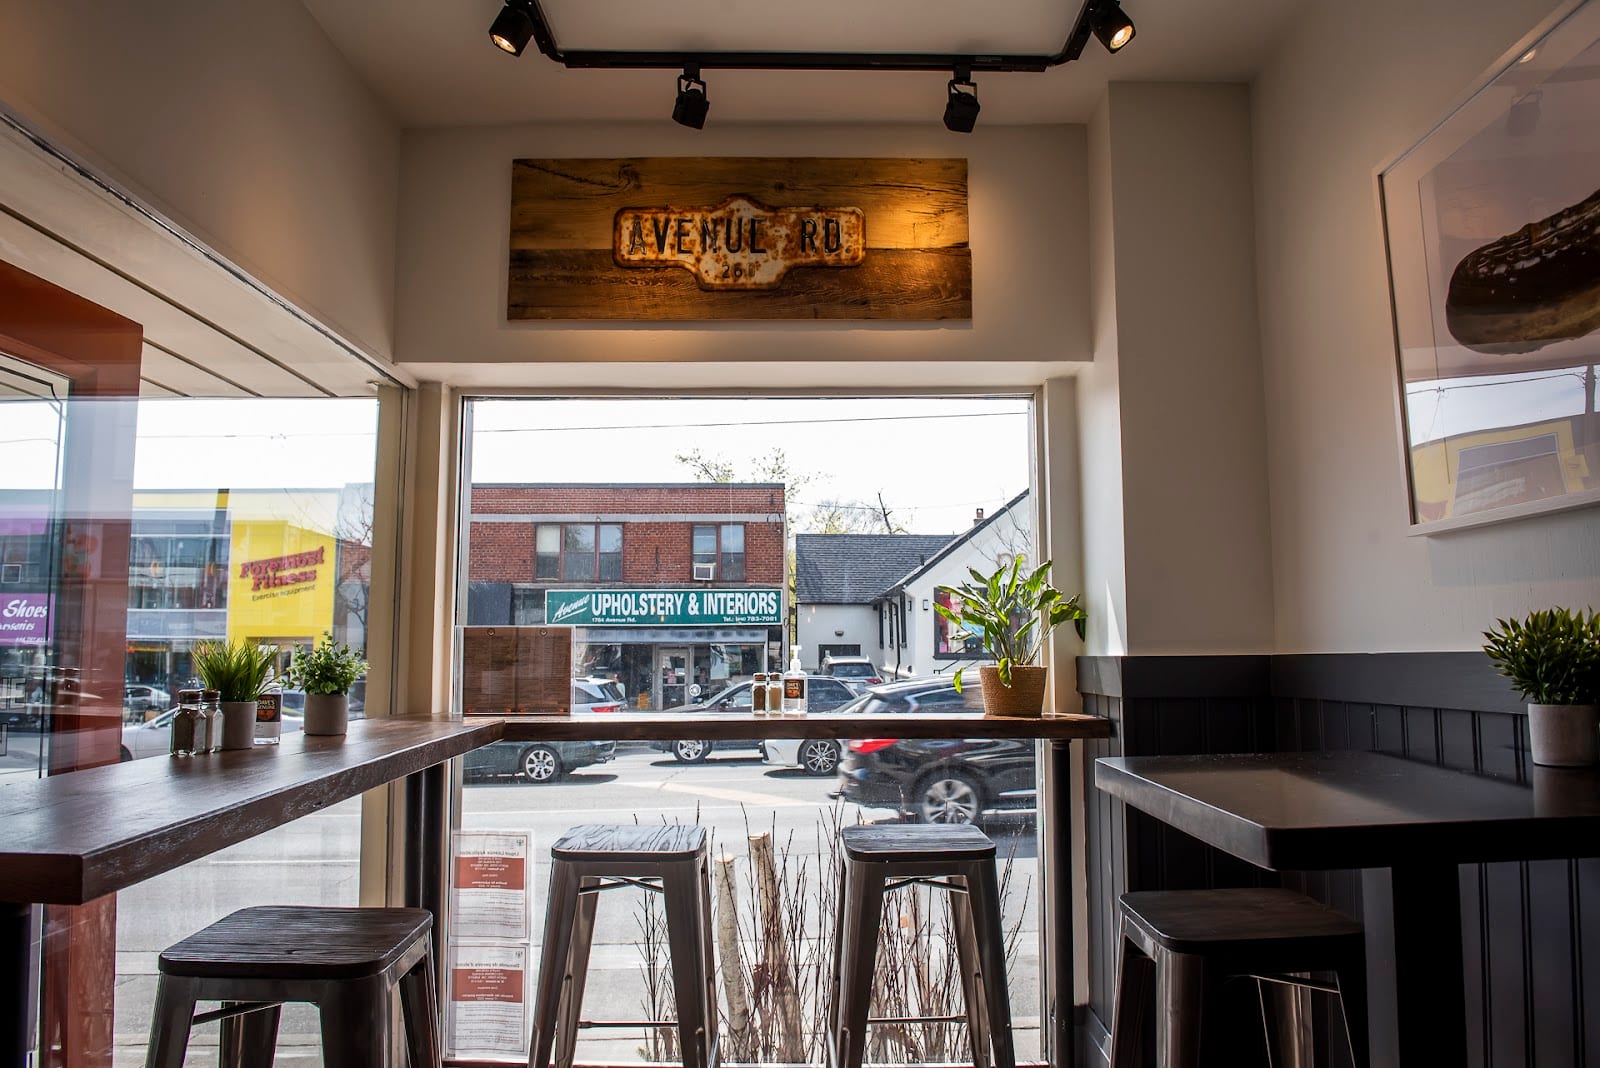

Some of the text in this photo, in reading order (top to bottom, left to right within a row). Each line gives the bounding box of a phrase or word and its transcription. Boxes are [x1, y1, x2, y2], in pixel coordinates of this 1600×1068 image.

[630, 217, 767, 255] AVENUE
[240, 545, 325, 579] Foremost
[251, 569, 317, 592] Fitness
[3, 599, 47, 618] Shoes
[552, 594, 590, 621] Avenue
[591, 592, 778, 616] UPHOLSTERY & INTERIORS
